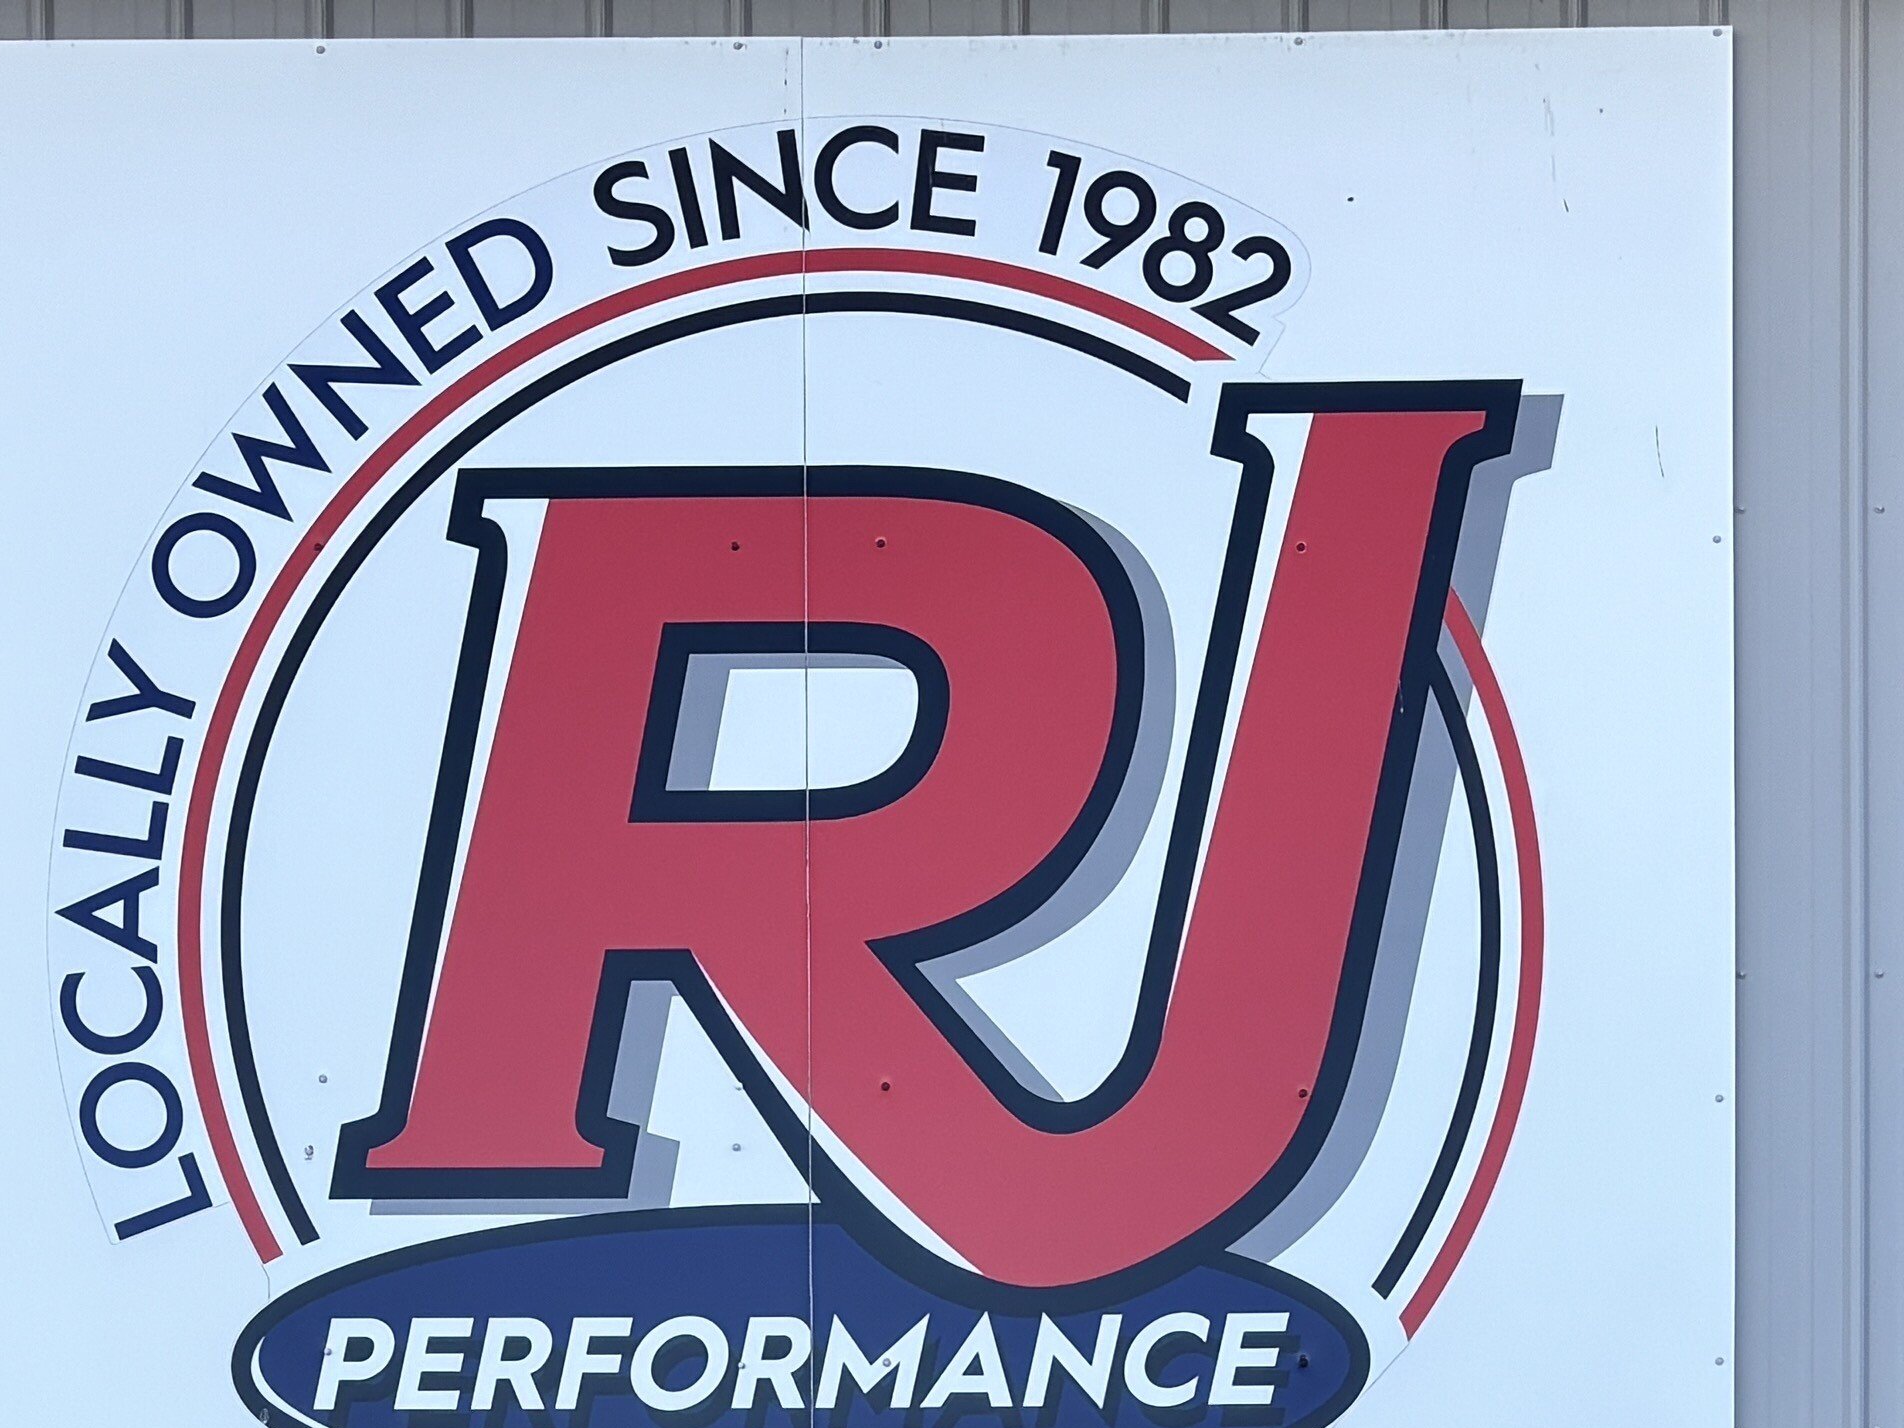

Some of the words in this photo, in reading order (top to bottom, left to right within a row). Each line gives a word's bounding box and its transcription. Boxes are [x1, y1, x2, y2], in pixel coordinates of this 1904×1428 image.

[55, 638, 213, 1240] LOCALLY
[152, 218, 553, 618] OWNED
[594, 126, 986, 267] SINCE
[1039, 150, 1292, 347] 1982
[329, 379, 1524, 1309] RJ
[312, 1311, 1291, 1411] PERFORMANCE
